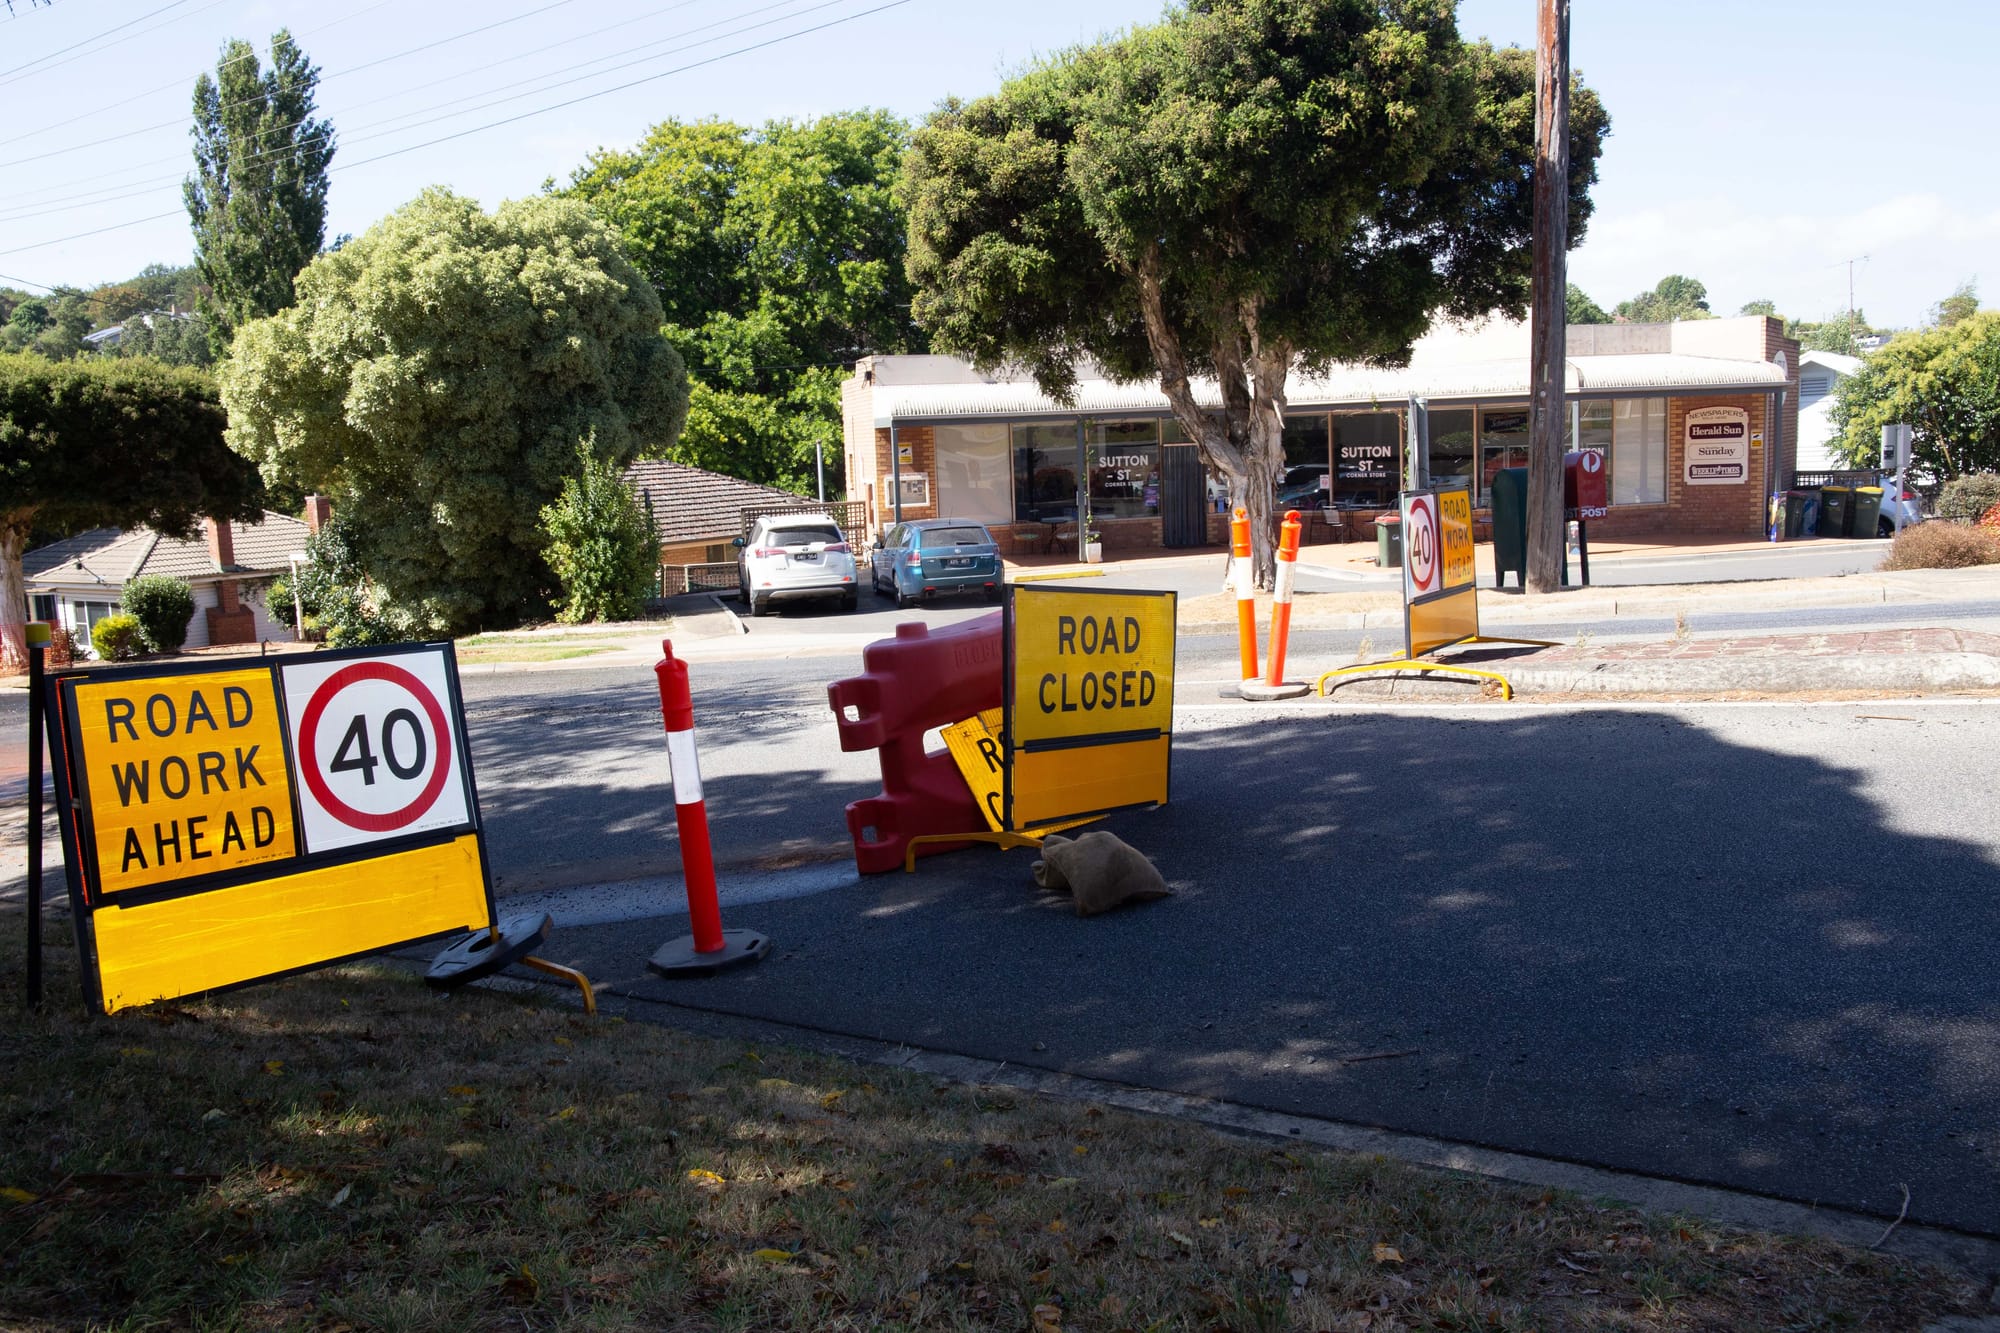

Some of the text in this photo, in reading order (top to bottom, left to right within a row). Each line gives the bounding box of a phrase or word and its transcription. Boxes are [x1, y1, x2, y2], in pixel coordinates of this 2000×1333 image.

[1689, 409, 1744, 419] NEWSPAPERS
[1691, 425, 1742, 436] Herald Sun
[1099, 455, 1149, 468] SUTTON
[1340, 446, 1392, 458] SUTTON
[1698, 446, 1736, 456] Sunday
[1116, 469, 1132, 480] ST
[1358, 460, 1374, 472] ST
[1443, 499, 1467, 521] ROAD
[1581, 507, 1608, 518] POST
[1412, 525, 1431, 566] 40
[1446, 526, 1470, 551] WORK
[1447, 555, 1472, 578] AHEAD
[1058, 615, 1141, 655] ROAD
[1039, 670, 1156, 714] CLOSED
[105, 686, 253, 743] ROAD
[329, 707, 427, 786] 40
[111, 744, 267, 808] WORK
[121, 805, 276, 873] AHEAD
